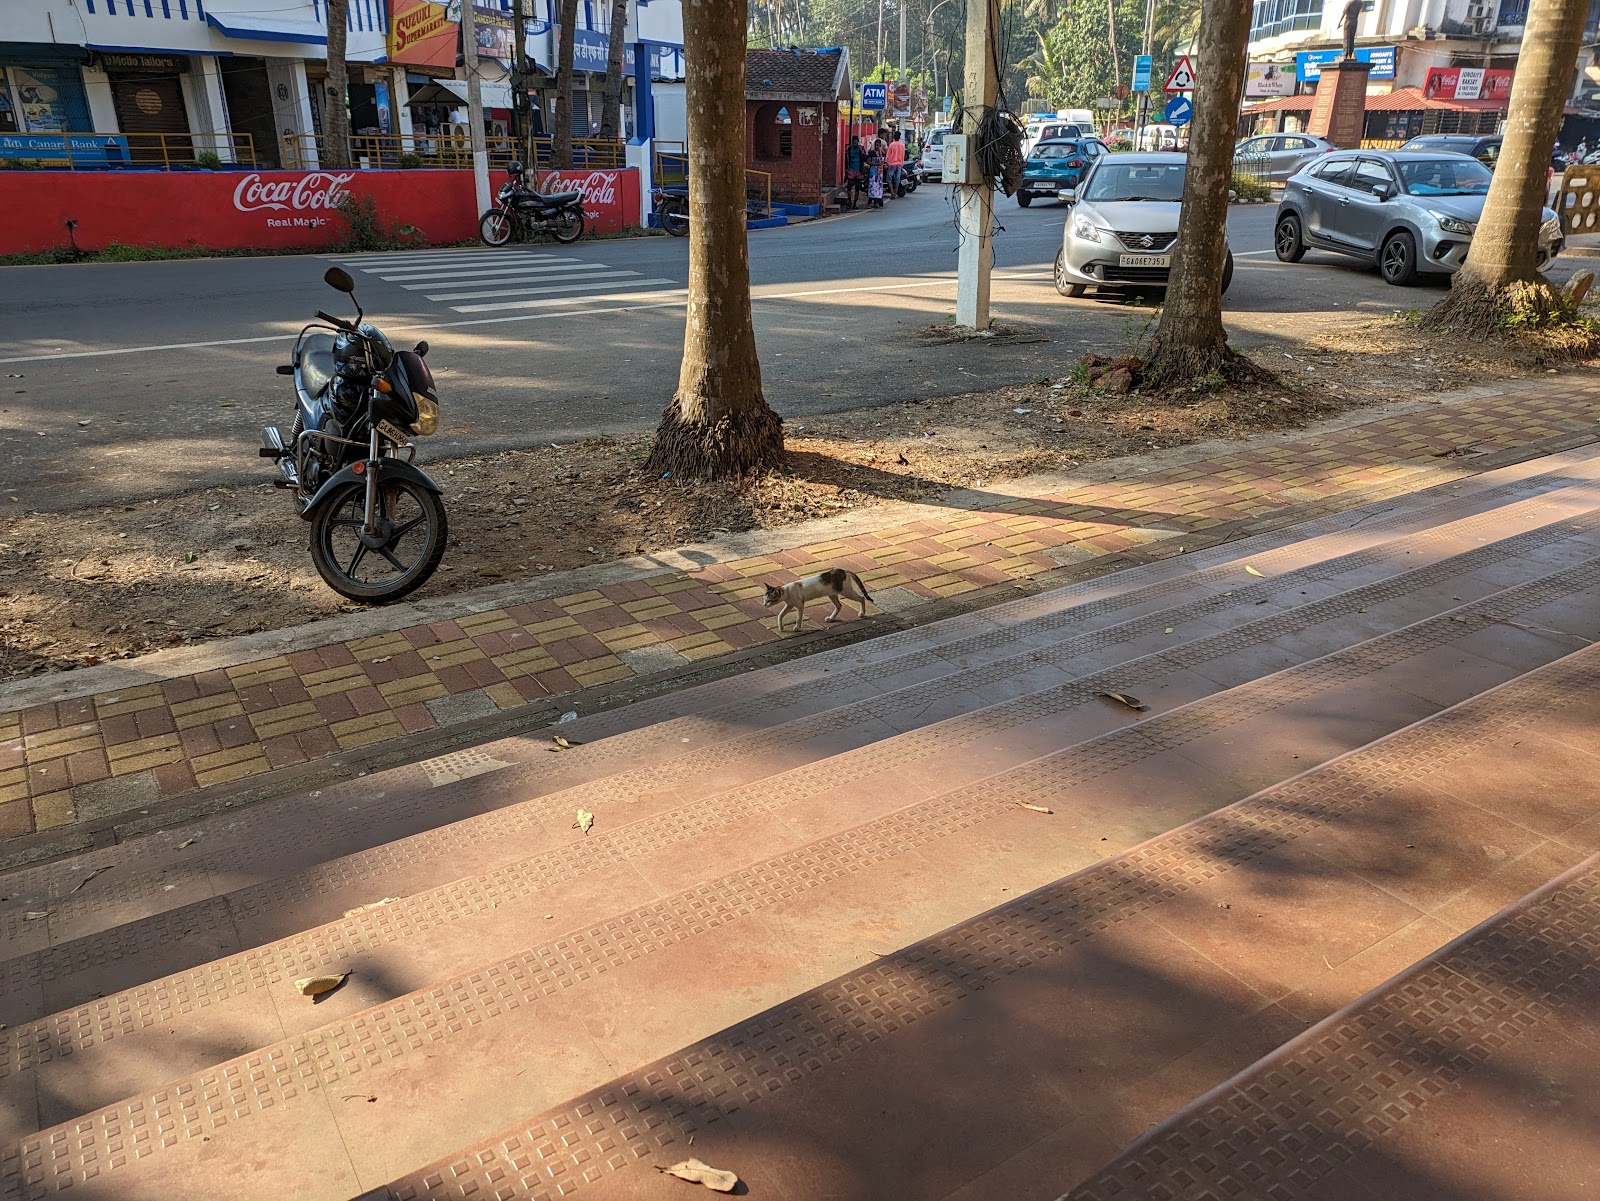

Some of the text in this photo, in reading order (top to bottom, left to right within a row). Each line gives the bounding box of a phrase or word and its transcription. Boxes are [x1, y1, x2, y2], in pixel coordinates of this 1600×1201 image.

[396, 5, 430, 51] SUZUKI
[141, 56, 173, 67] Tailors
[864, 88, 885, 98] ATM
[72, 140, 99, 150] Bank
[233, 172, 355, 211] Coca-Cola
[267, 217, 326, 230] Real Magic
